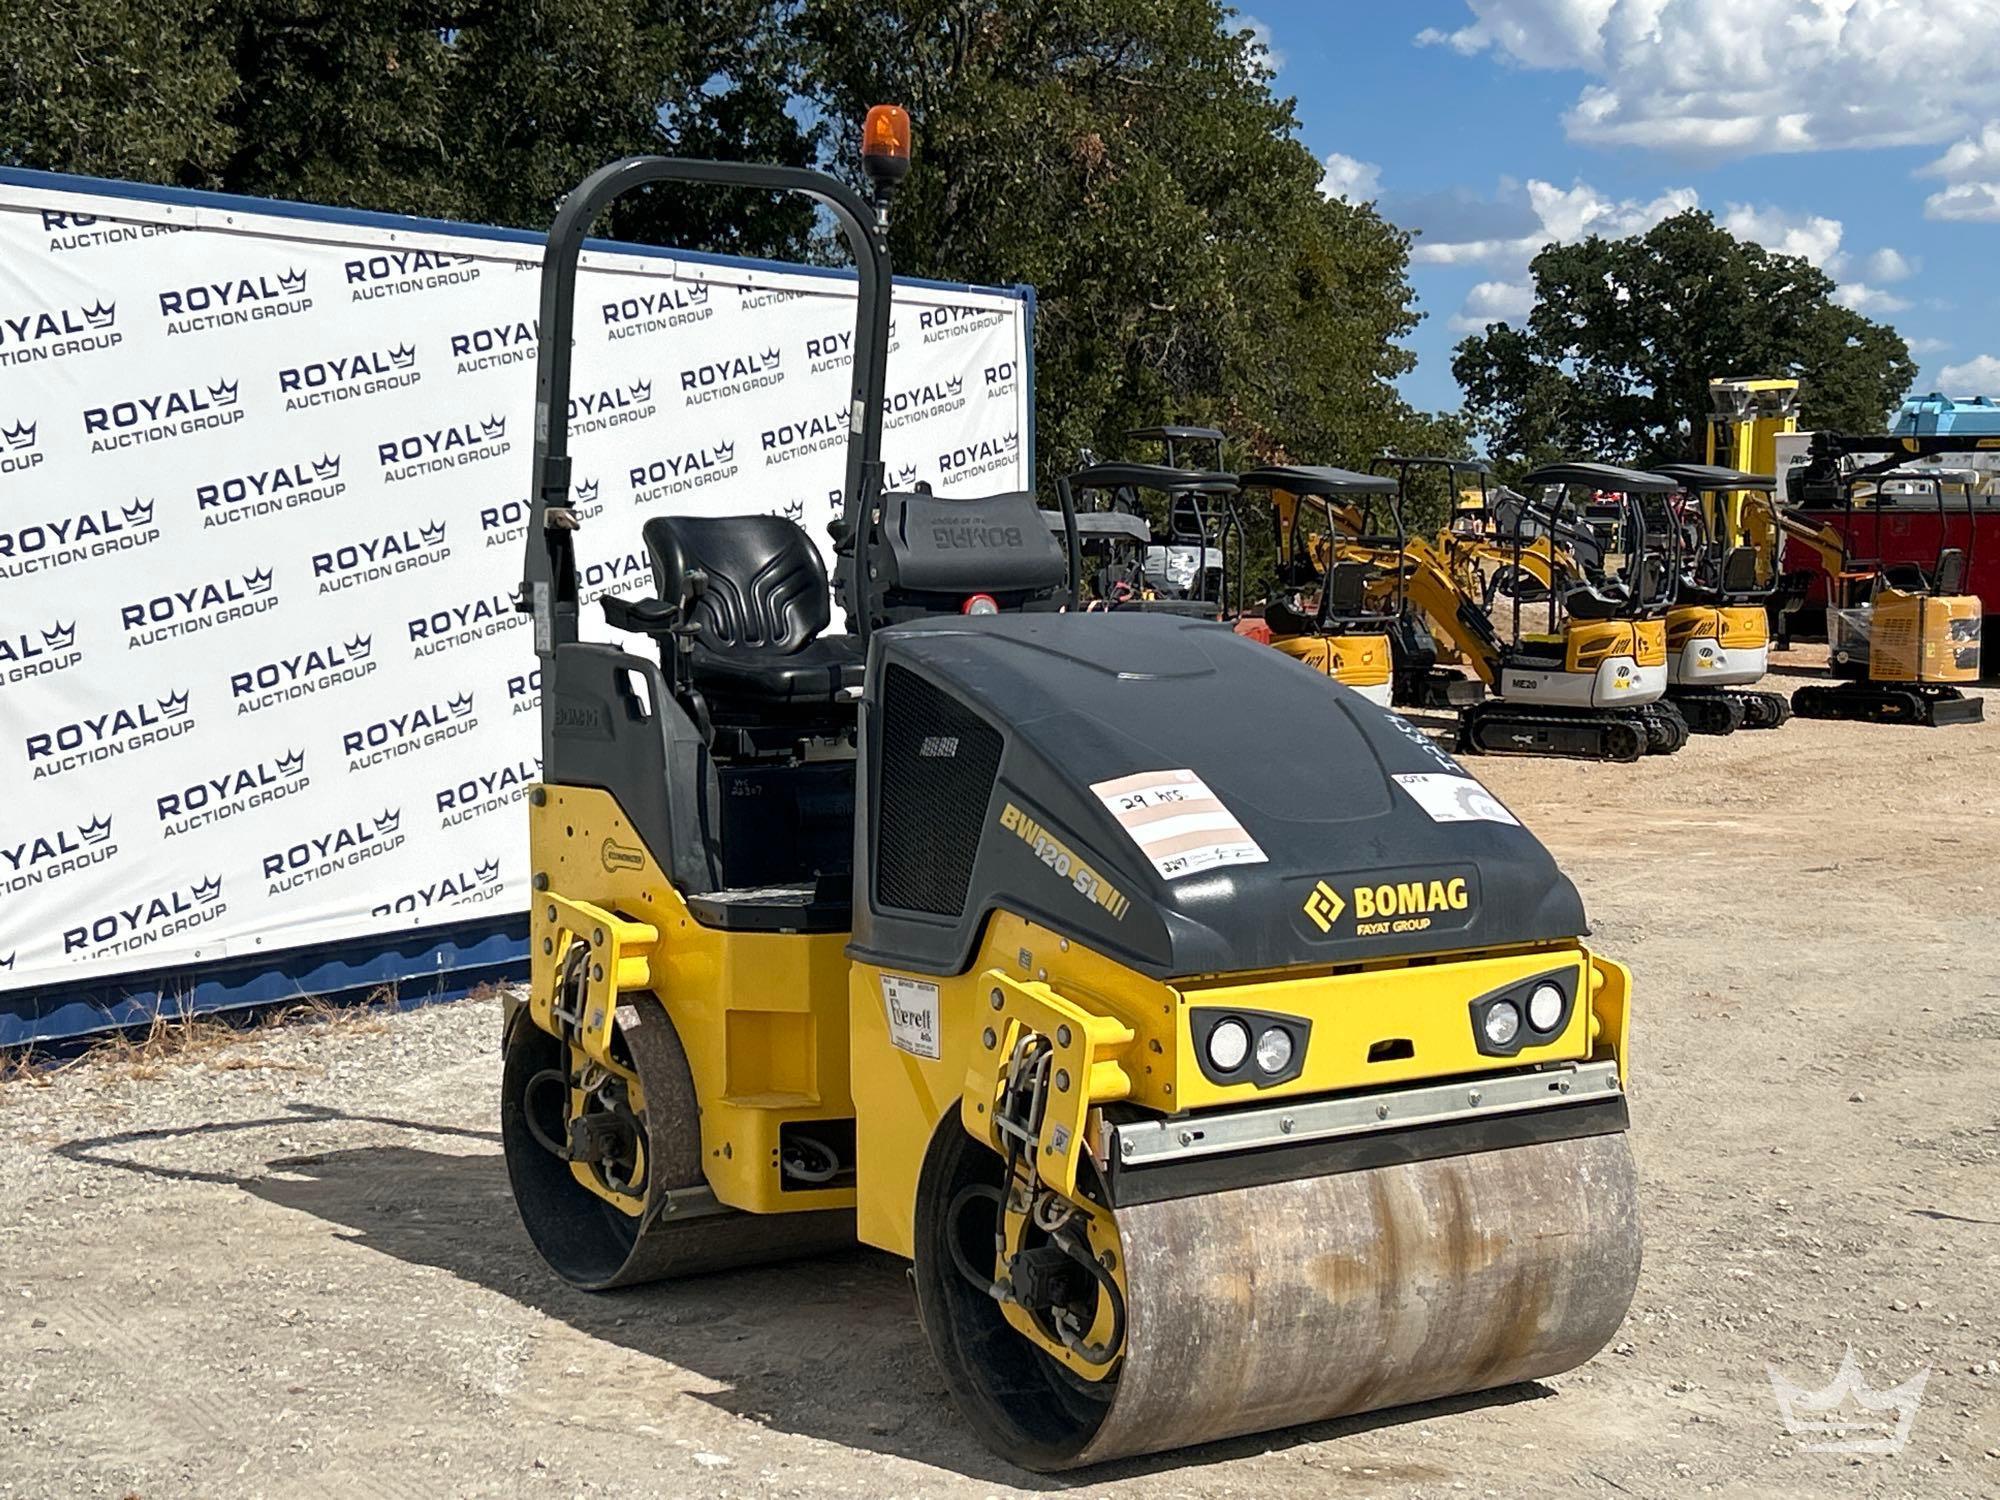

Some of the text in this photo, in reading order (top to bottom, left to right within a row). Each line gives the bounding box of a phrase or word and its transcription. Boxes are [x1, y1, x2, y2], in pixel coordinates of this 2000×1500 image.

[50, 227, 137, 252] AUCTION
[345, 250, 450, 284] ROYAL
[352, 269, 480, 302] AUCTION GROUP
[159, 277, 279, 316] ROYAL
[602, 290, 688, 324] ROYAL
[168, 299, 312, 336] AUCTION GROUP
[609, 308, 712, 340] AUCTION GROUP
[923, 312, 1004, 344] AUCTION GROUP
[52, 333, 122, 356] GROUP
[457, 350, 523, 374] AUCTION
[279, 352, 390, 393] ROYAL
[286, 372, 420, 411] AUCTION GROUP
[681, 356, 761, 390] ROYAL
[686, 373, 784, 406] AUCTION GROUP
[84, 389, 210, 434] ROYAL
[610, 406, 655, 426] GROUP
[883, 398, 965, 430] AUCTION GROUP
[92, 410, 244, 453] AUCTION GROUP
[378, 424, 482, 466] ROYAL
[762, 415, 837, 450] ROYAL
[385, 442, 510, 482] AUCTION GROUP
[630, 450, 714, 488] ROYAL
[766, 443, 817, 465] AUCTION
[939, 439, 1003, 472] ROYAL
[197, 464, 313, 510] ROYAL
[635, 466, 738, 504] AUCTION GROUP
[943, 465, 986, 487] AUCTION
[204, 483, 345, 529] AUCTION GROUP
[92, 529, 159, 556] GROUP
[312, 531, 420, 577] ROYAL
[320, 548, 450, 594] AUCTION GROUP
[121, 580, 244, 630] ROYAL
[129, 597, 278, 649] AUCTION GROUP
[408, 596, 509, 642] ROYAL
[415, 628, 482, 659] AUCTION
[9, 652, 82, 682] GROUP
[231, 646, 345, 697] ROYAL
[238, 662, 376, 715] AUCTION GROUP
[26, 704, 158, 761] ROYAL
[344, 705, 448, 756] ROYAL
[350, 719, 478, 772] AUCTION GROUP
[34, 720, 194, 780] AUCTION GROUP
[157, 764, 276, 820] ROYAL
[436, 762, 534, 812] ROYAL
[1120, 795, 1149, 809] 29
[164, 778, 309, 838] AUCTION GROUP
[442, 794, 508, 829] AUCTION
[48, 845, 118, 878] GROUP
[263, 823, 374, 879] ROYAL
[269, 835, 404, 896] AUCTION GROUP
[1354, 877, 1468, 919] BOMAG
[64, 892, 191, 954] ROYAL
[161, 903, 227, 938] GROUP
[1357, 918, 1431, 936] FAYAT GROUP
